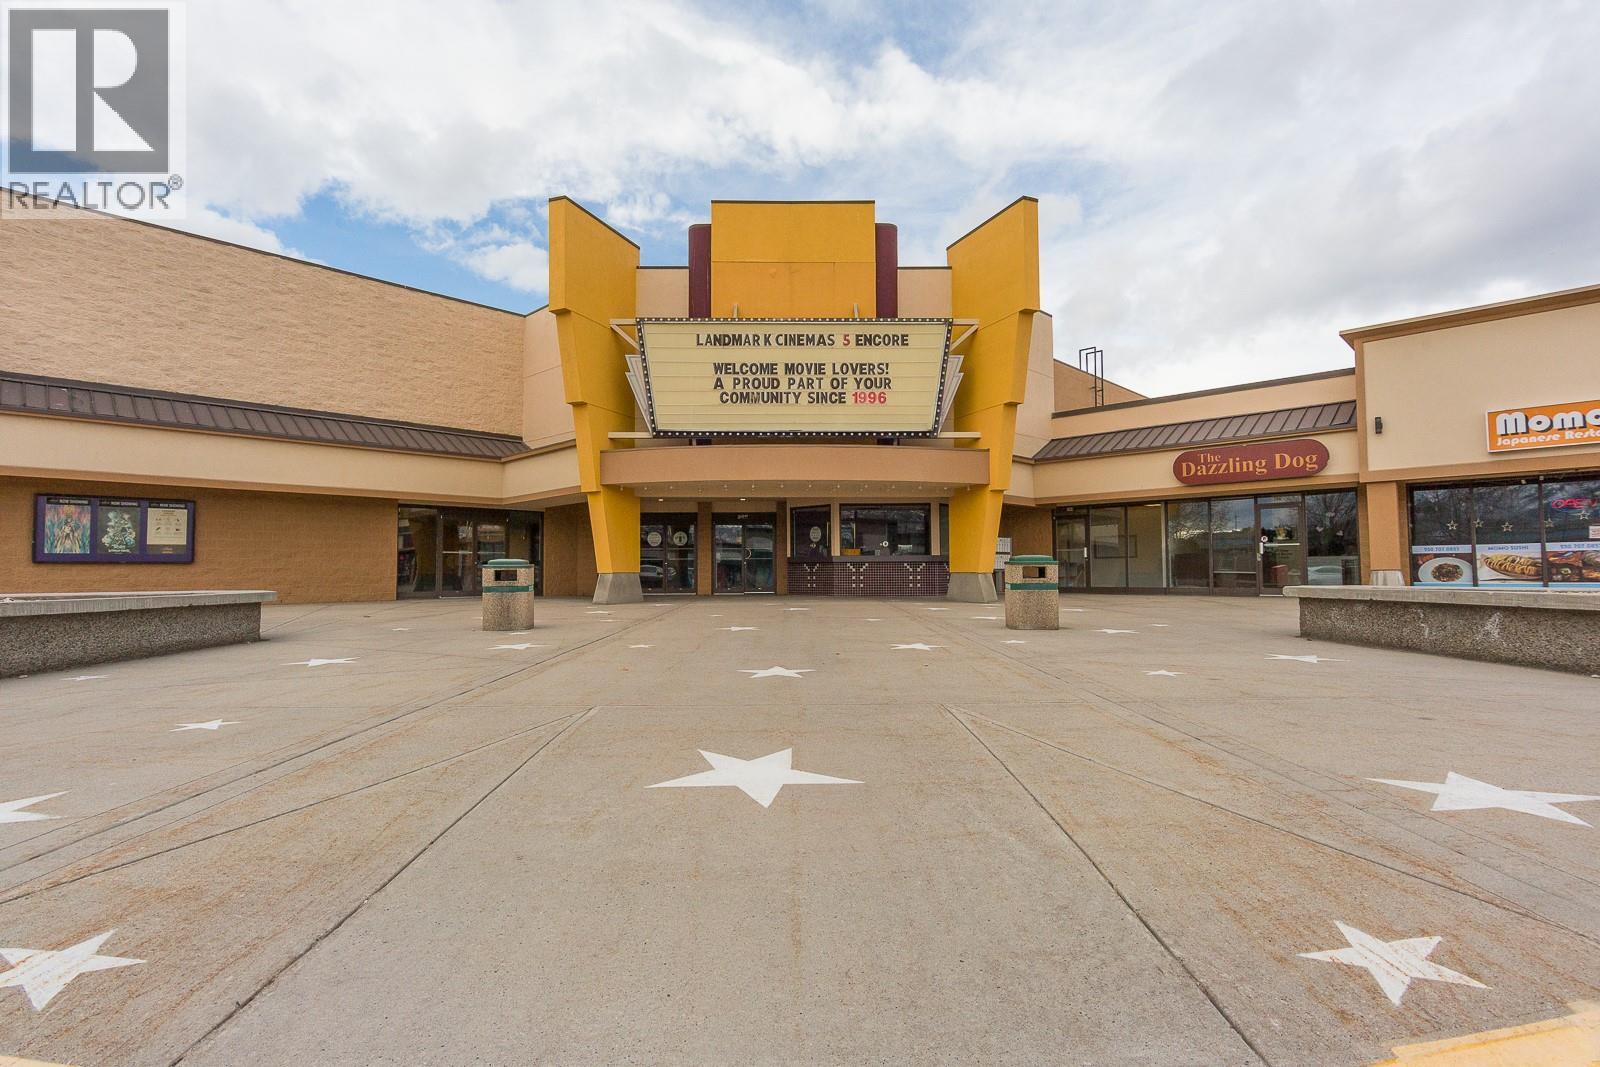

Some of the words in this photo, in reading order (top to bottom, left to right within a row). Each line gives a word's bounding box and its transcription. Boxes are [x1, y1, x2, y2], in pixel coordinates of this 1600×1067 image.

[696, 333, 772, 347] LANDMARK
[775, 333, 836, 347] CINEMAS
[842, 333, 851, 347] 5
[855, 333, 909, 347] ENCORE
[713, 362, 778, 375] WELCOME
[784, 362, 826, 375] MOVIE
[832, 362, 890, 375] LOVERS!
[713, 377, 725, 390] A
[732, 377, 780, 390] PROUD
[787, 377, 824, 390] PART
[830, 377, 848, 390] OF
[853, 377, 892, 390] YOUR
[719, 391, 802, 404] COMMUNITY
[807, 391, 847, 404] SINCE
[852, 391, 887, 404] 1996
[1496, 433, 1561, 447] Japanese
[1198, 453, 1221, 463] The
[1181, 457, 1268, 477] Dazzling
[1274, 453, 1319, 472] Dog
